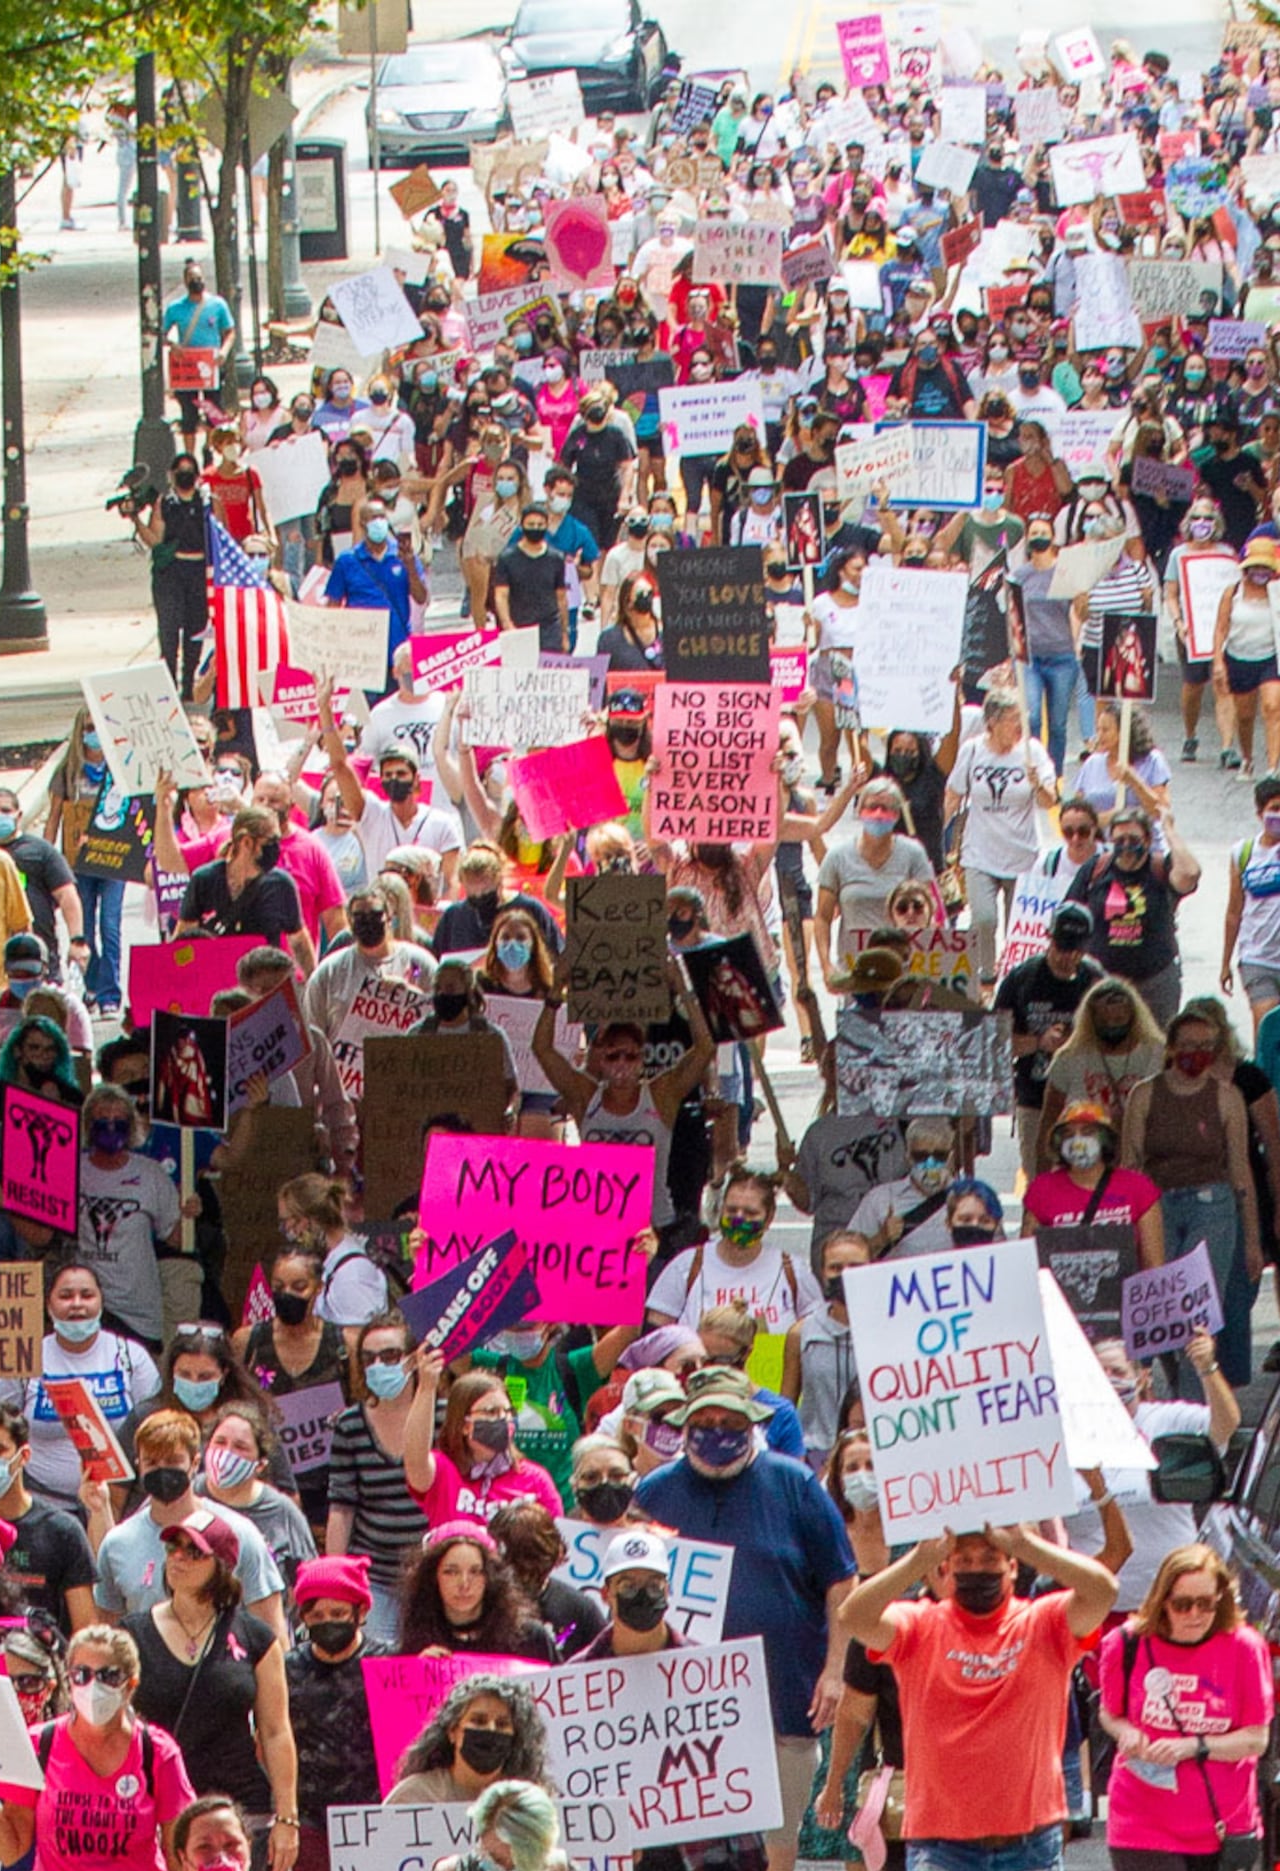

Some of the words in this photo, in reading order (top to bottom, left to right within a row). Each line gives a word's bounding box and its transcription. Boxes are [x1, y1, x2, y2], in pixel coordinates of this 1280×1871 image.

[710, 584, 765, 604] LOVE
[417, 647, 456, 674] BANS
[455, 631, 484, 657] OFF
[678, 634, 761, 657] CHOICE
[427, 669, 451, 686] MY
[452, 651, 487, 674] BODY
[672, 690, 705, 710] NO
[718, 691, 771, 710] SIGN
[688, 711, 705, 728] IS
[717, 711, 754, 729] BIG
[667, 729, 766, 750] ENOUGH
[668, 750, 699, 769] TO
[709, 751, 754, 771] LIST
[672, 771, 751, 791] EVERY
[656, 794, 756, 814] REASON
[764, 796, 771, 814] I
[659, 816, 696, 835] AM
[707, 819, 771, 837] HERE
[2, 1183, 72, 1221] RESIST
[456, 1158, 530, 1208] MY
[541, 1165, 640, 1220] BODY
[427, 1232, 484, 1274] MY
[888, 1254, 996, 1318] MEN
[916, 1312, 973, 1355] OF
[868, 1335, 1040, 1402] QUALITY
[872, 1394, 960, 1451] DONT
[976, 1375, 1060, 1426] FEAR
[883, 1441, 1060, 1521] EQUALITY
